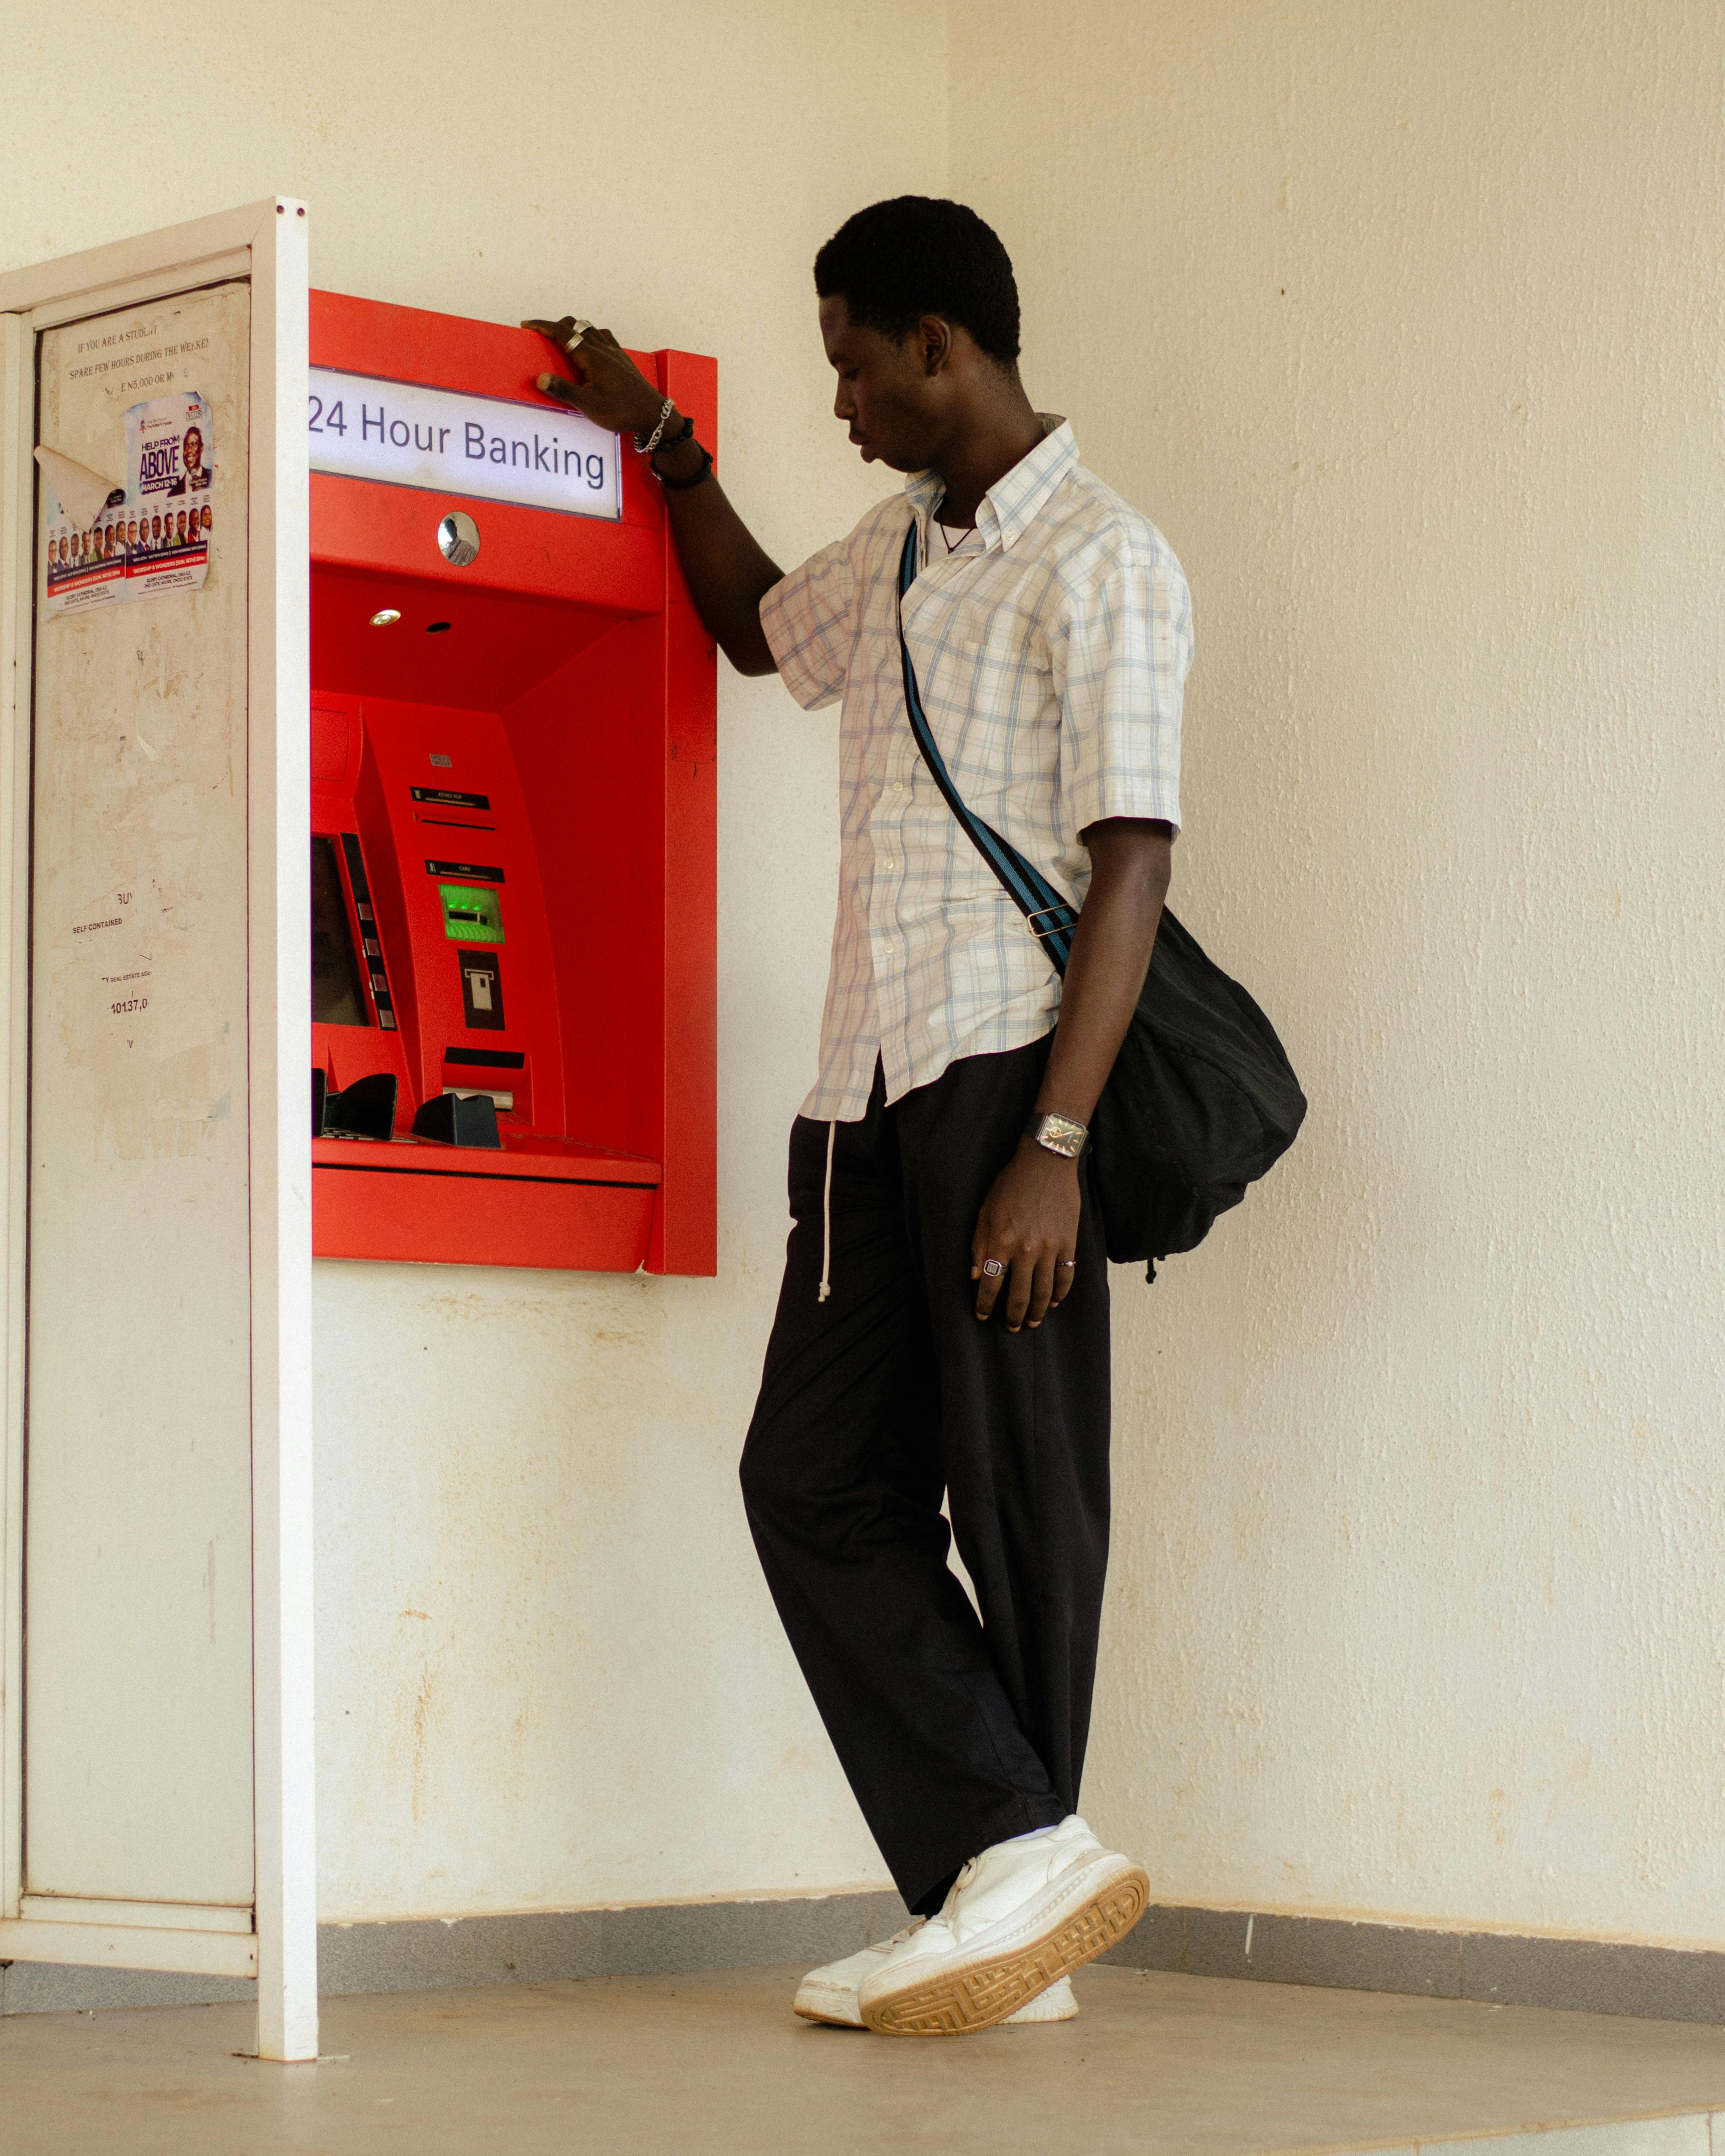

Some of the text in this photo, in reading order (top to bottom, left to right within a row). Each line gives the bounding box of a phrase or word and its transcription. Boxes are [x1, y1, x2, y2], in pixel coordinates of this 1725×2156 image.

[78, 344, 84, 353] IF
[86, 339, 100, 351] YOU
[102, 335, 117, 347] ARE
[118, 333, 124, 343] A
[70, 366, 93, 380] SPARE
[94, 360, 110, 374] FEW
[111, 356, 134, 370] HOURS
[136, 349, 162, 364] DURING
[164, 345, 178, 357] THE
[155, 373, 164, 384] OR
[142, 434, 180, 451] HELP FROM
[309, 396, 603, 490] 24 Hour Banking
[139, 445, 180, 481] ABOVE
[142, 480, 164, 492] MARCH
[164, 479, 177, 488] 12-16
[73, 918, 122, 934] SELF CONTAINED
